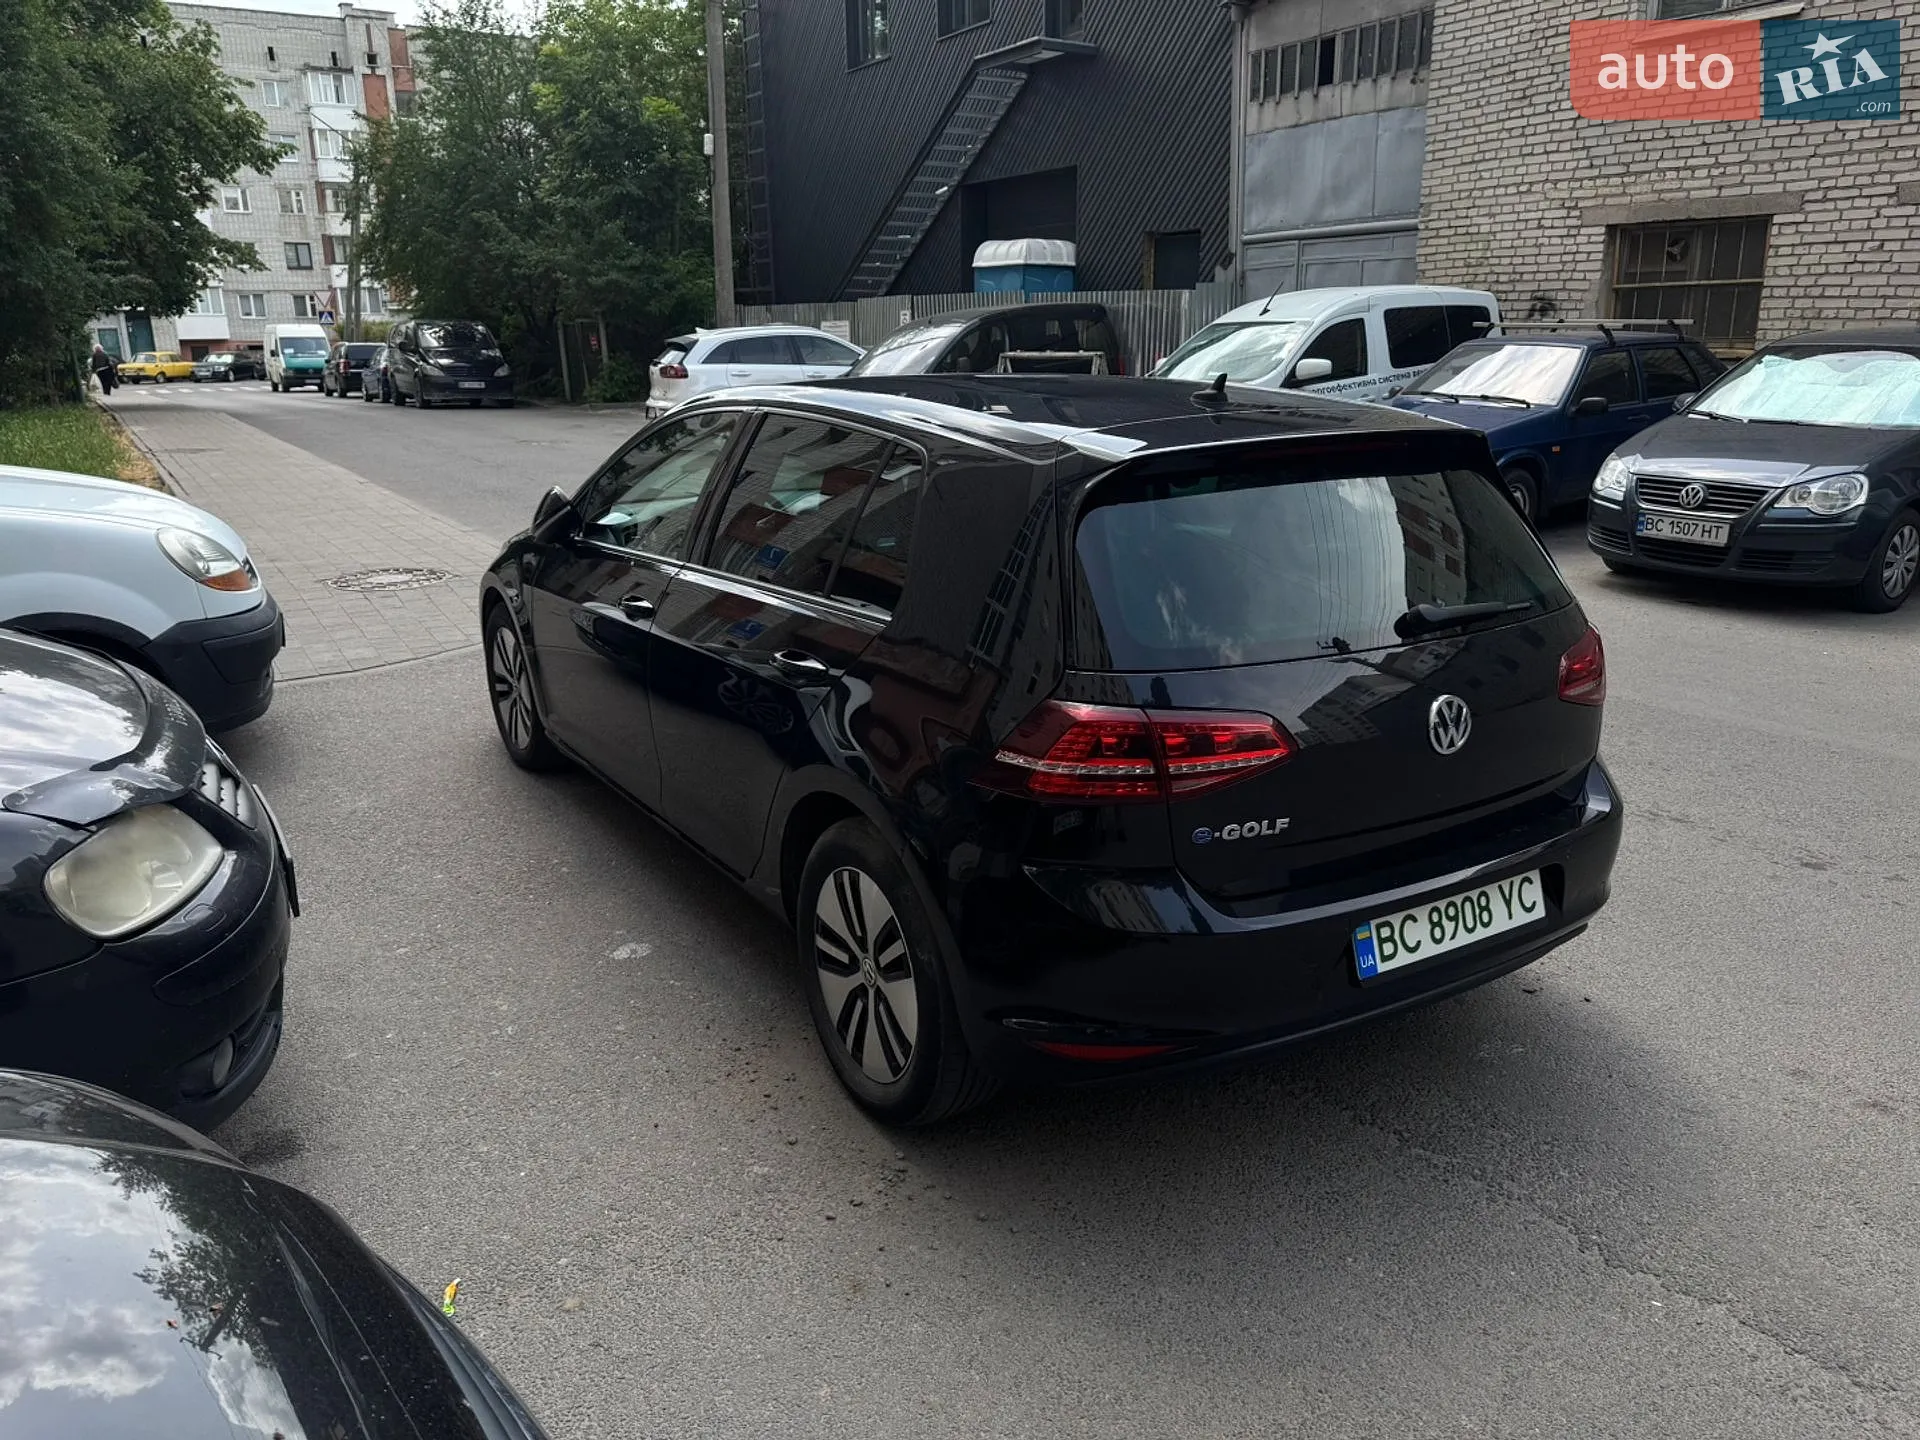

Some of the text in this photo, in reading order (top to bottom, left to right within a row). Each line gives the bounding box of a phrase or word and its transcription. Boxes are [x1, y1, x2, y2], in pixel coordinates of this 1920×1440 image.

[1644, 517, 1723, 540] BC 1507 HT
[1374, 876, 1537, 964] BC 8908 YC
[1360, 954, 1376, 969] UA
